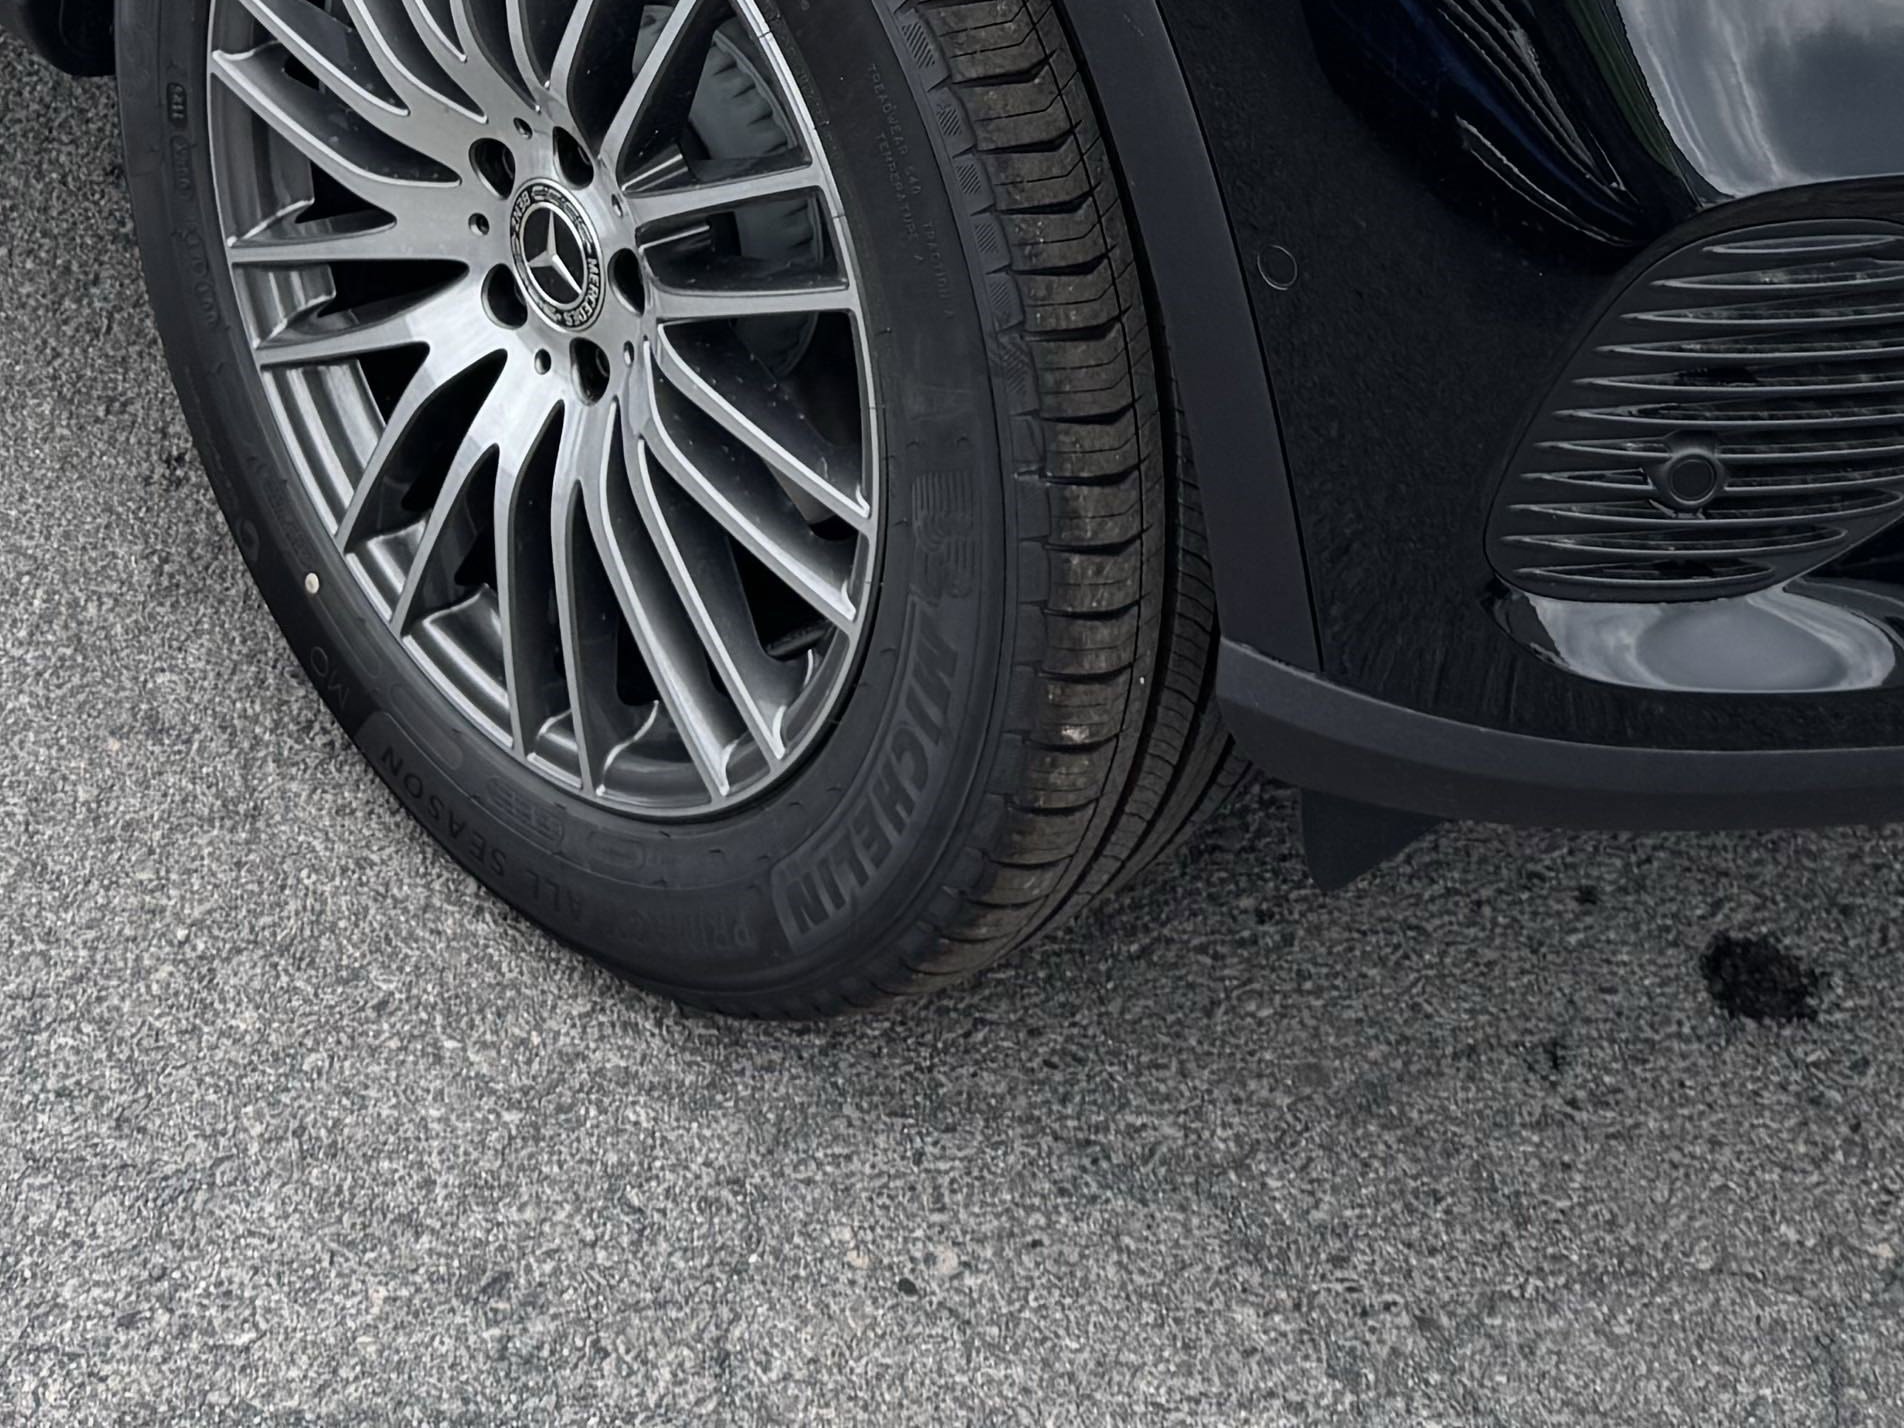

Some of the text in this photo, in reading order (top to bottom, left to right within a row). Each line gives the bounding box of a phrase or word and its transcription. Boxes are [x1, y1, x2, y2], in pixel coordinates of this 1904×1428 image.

[563, 258, 600, 326] MERCEDES
[379, 745, 508, 878] SEASON
[786, 610, 960, 936] MICHELIN
